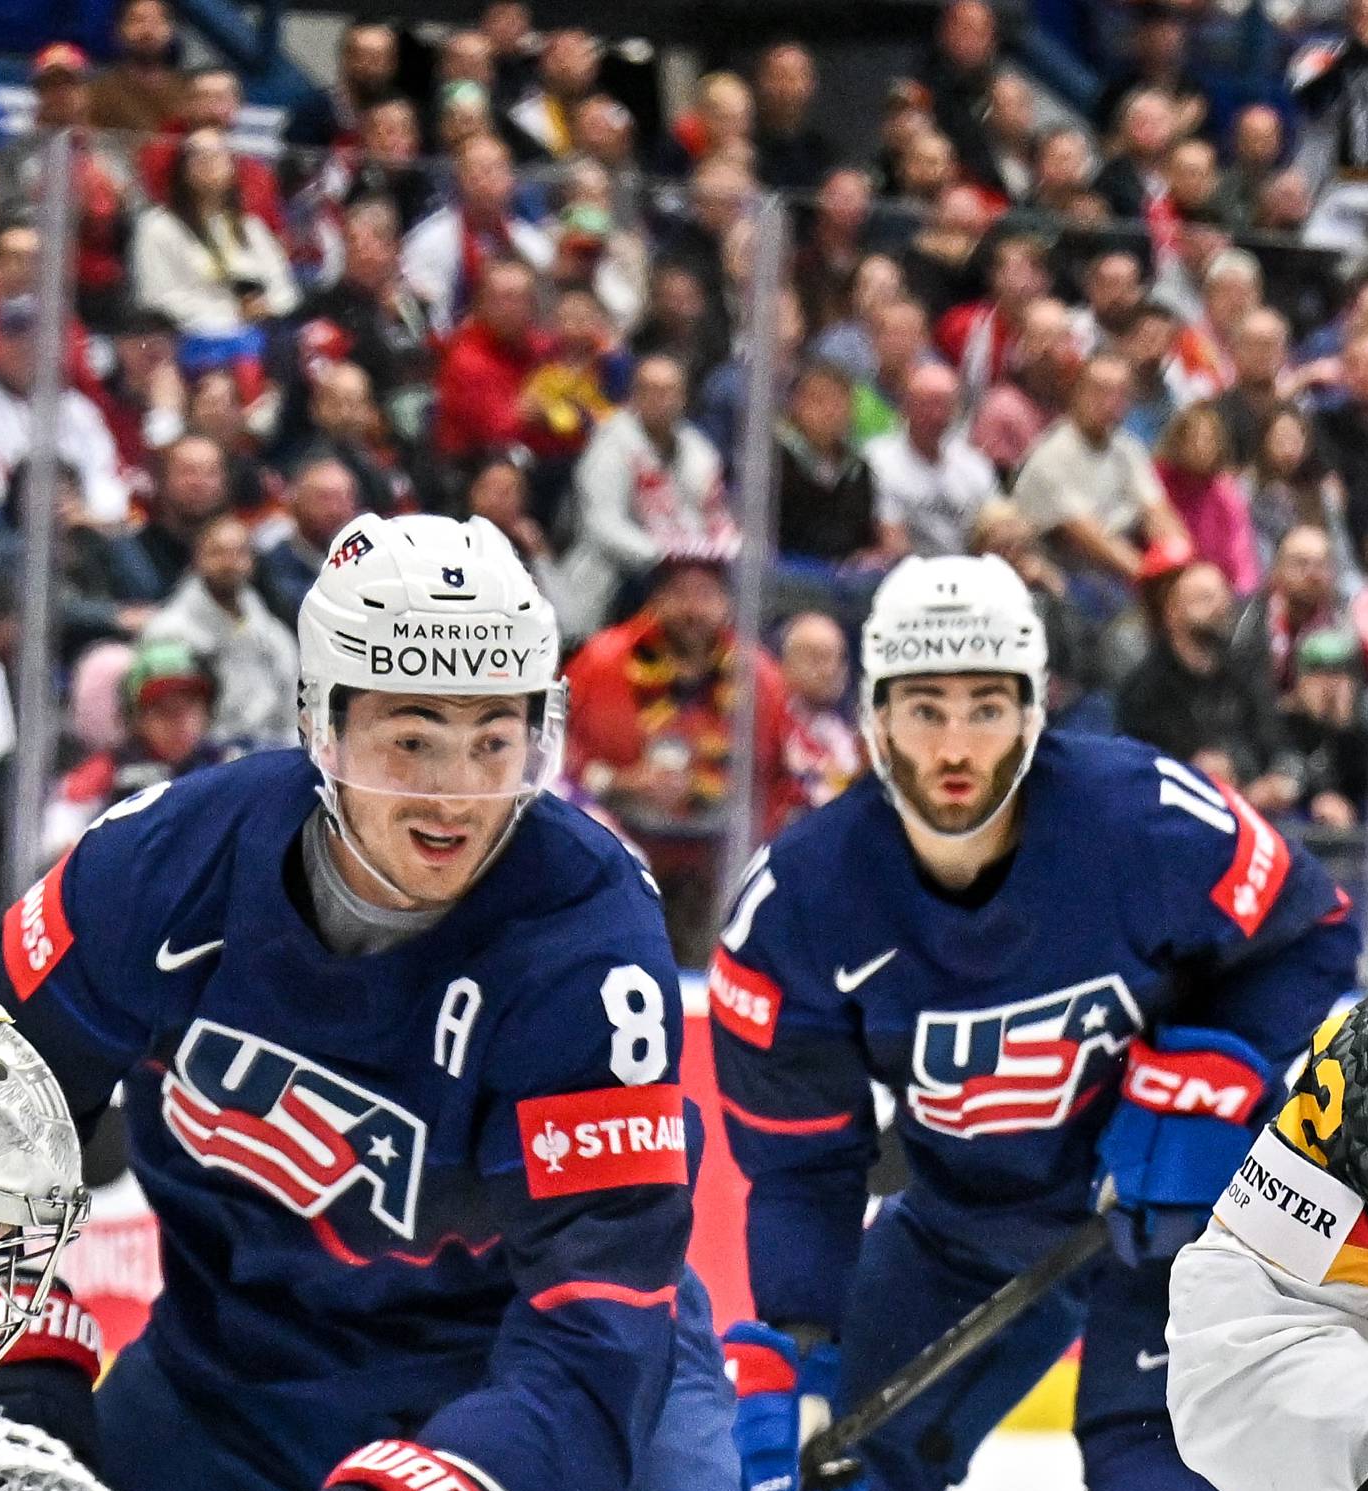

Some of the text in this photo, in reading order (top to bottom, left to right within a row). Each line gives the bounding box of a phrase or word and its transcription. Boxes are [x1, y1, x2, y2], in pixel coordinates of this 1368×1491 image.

[371, 645, 531, 677] BONVOY
[393, 622, 514, 641] MARRIOTT
[884, 635, 1005, 664] BONVOY
[433, 975, 484, 1079] A
[600, 963, 669, 1087] 8
[906, 972, 1147, 1140] USA
[161, 1018, 428, 1240] USA
[1128, 1063, 1249, 1119] CM
